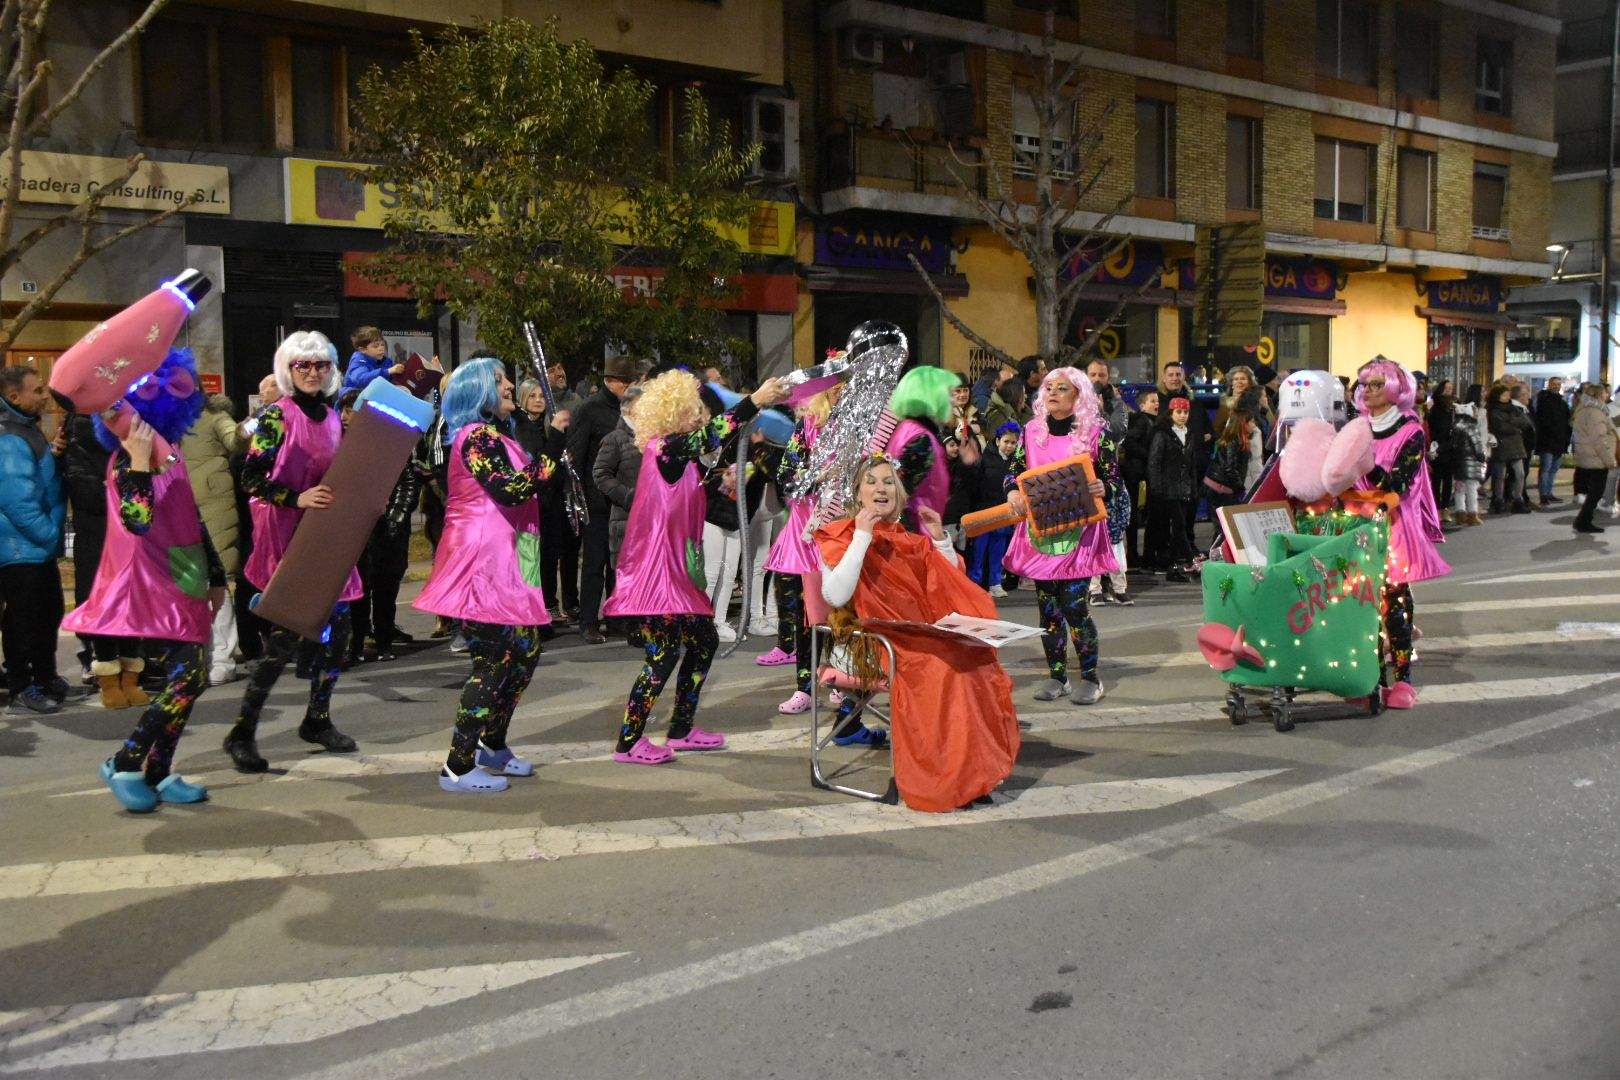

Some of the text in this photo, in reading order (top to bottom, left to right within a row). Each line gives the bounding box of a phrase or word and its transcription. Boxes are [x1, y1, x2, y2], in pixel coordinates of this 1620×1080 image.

[87, 180, 184, 204] Cnsulting
[194, 188, 226, 204] S.L.
[1438, 282, 1491, 305] GANGA
